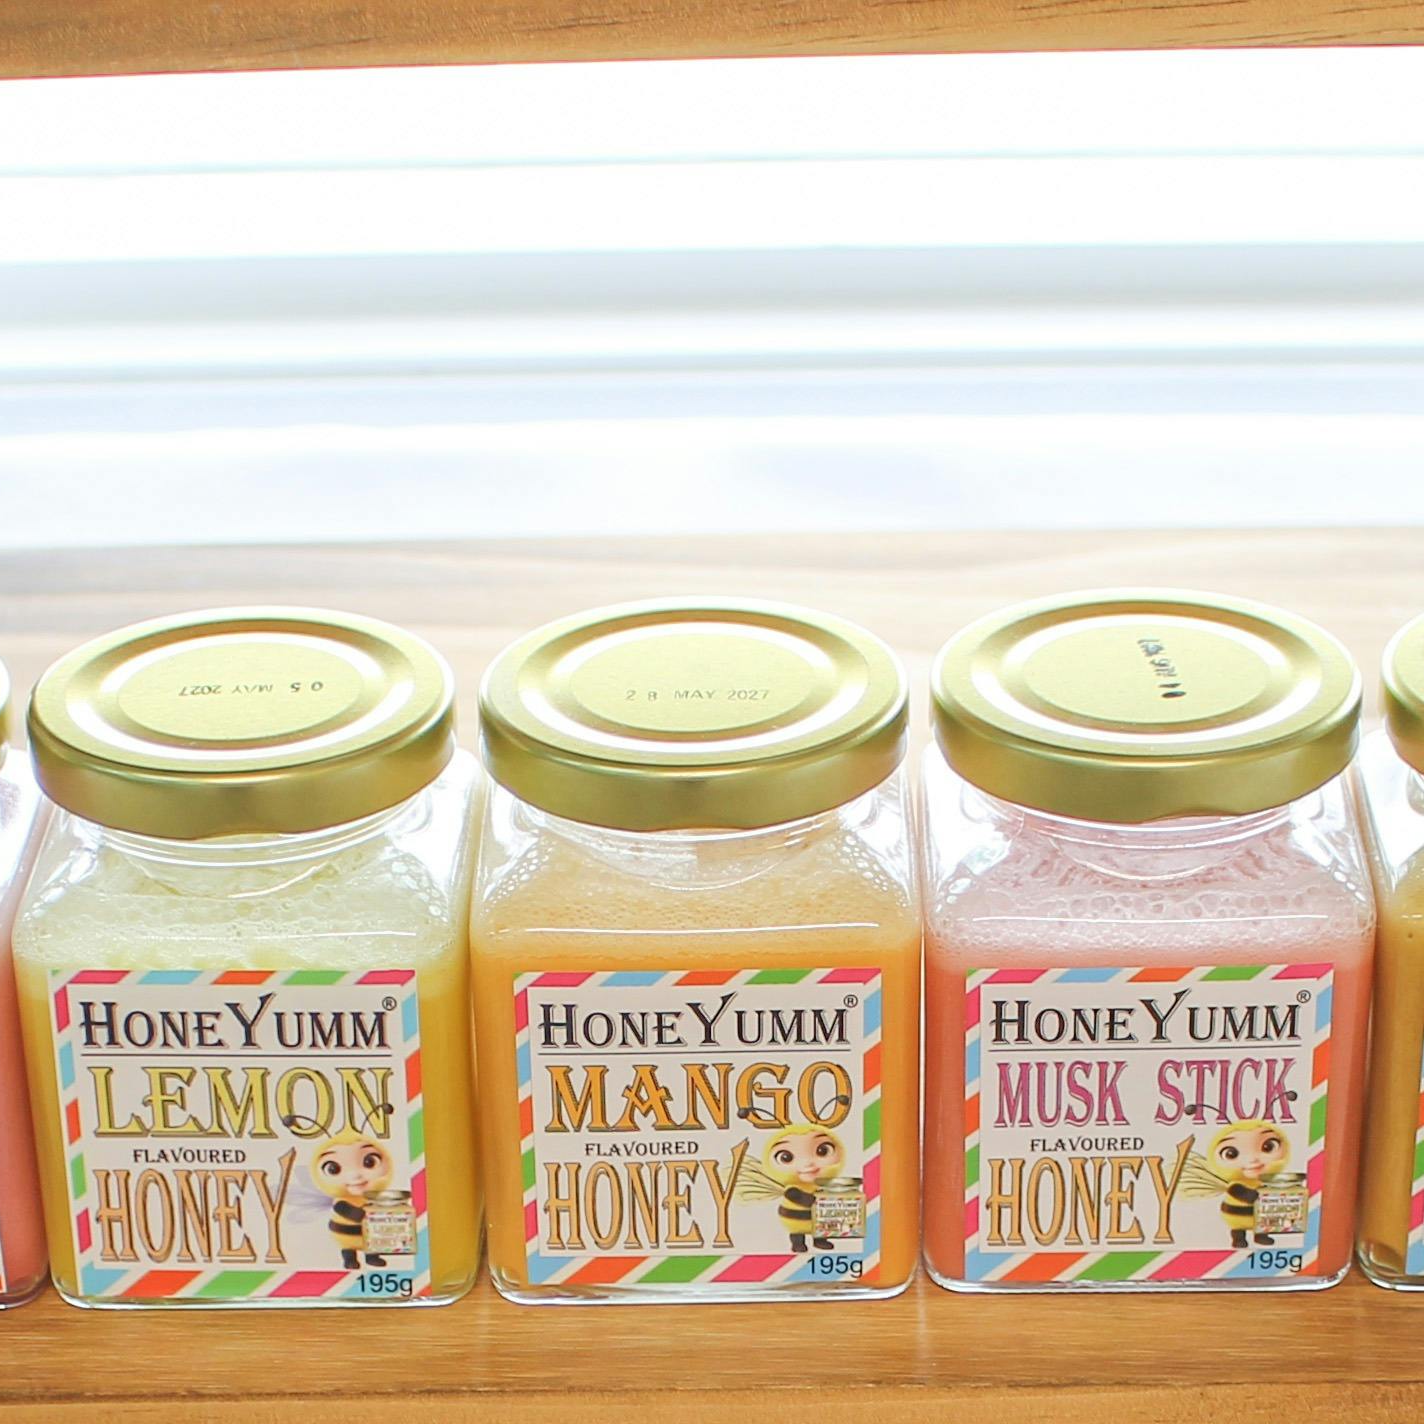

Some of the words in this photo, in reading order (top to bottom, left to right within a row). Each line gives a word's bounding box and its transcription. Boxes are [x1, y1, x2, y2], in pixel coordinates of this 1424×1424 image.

[178, 685, 222, 696] 2027
[674, 690, 716, 699] MAY
[727, 690, 770, 700] 2027
[93, 1065, 394, 1138] LEMON
[544, 1061, 853, 1132] MANGO
[994, 1061, 1130, 1128] MUSK
[1156, 1058, 1297, 1127] STICK
[133, 1149, 246, 1164] FLAVOURED
[585, 1141, 699, 1156] FLAVOURED
[1030, 1137, 1144, 1153] FLAVOURED
[95, 1144, 294, 1263] HONEY
[543, 1139, 751, 1250] HONEY
[986, 1137, 1194, 1253] HONEY
[807, 1255, 863, 1279] 195g
[1245, 1251, 1303, 1275] 195g
[355, 1274, 414, 1297] 195g
